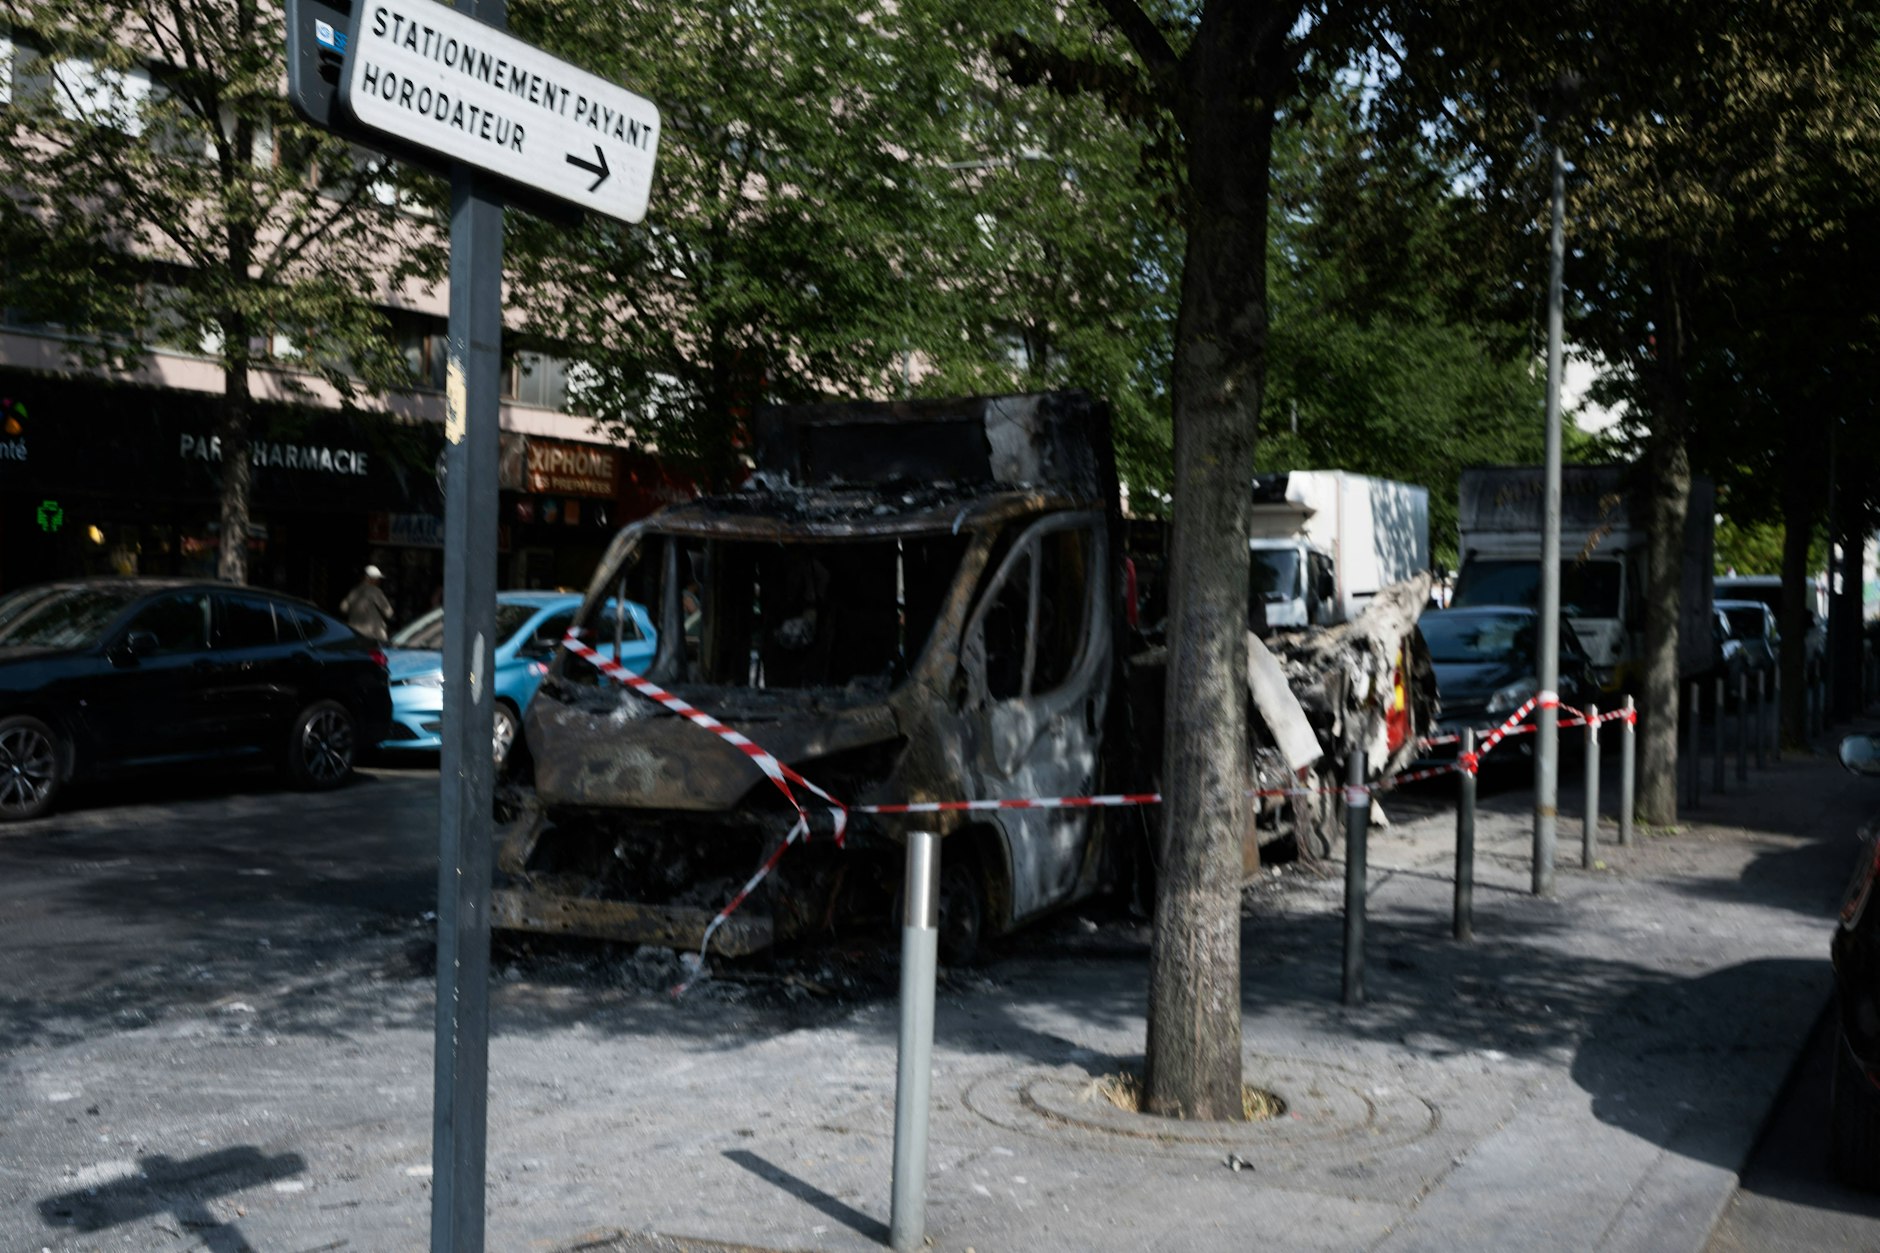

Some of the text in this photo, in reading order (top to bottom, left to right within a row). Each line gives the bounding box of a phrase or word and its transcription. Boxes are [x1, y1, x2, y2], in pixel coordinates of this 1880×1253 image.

[362, 61, 526, 153] HORODATEUR
[373, 7, 653, 152] STATIONNEMENT PAYANT
[180, 432, 368, 476] PARHARMACIE
